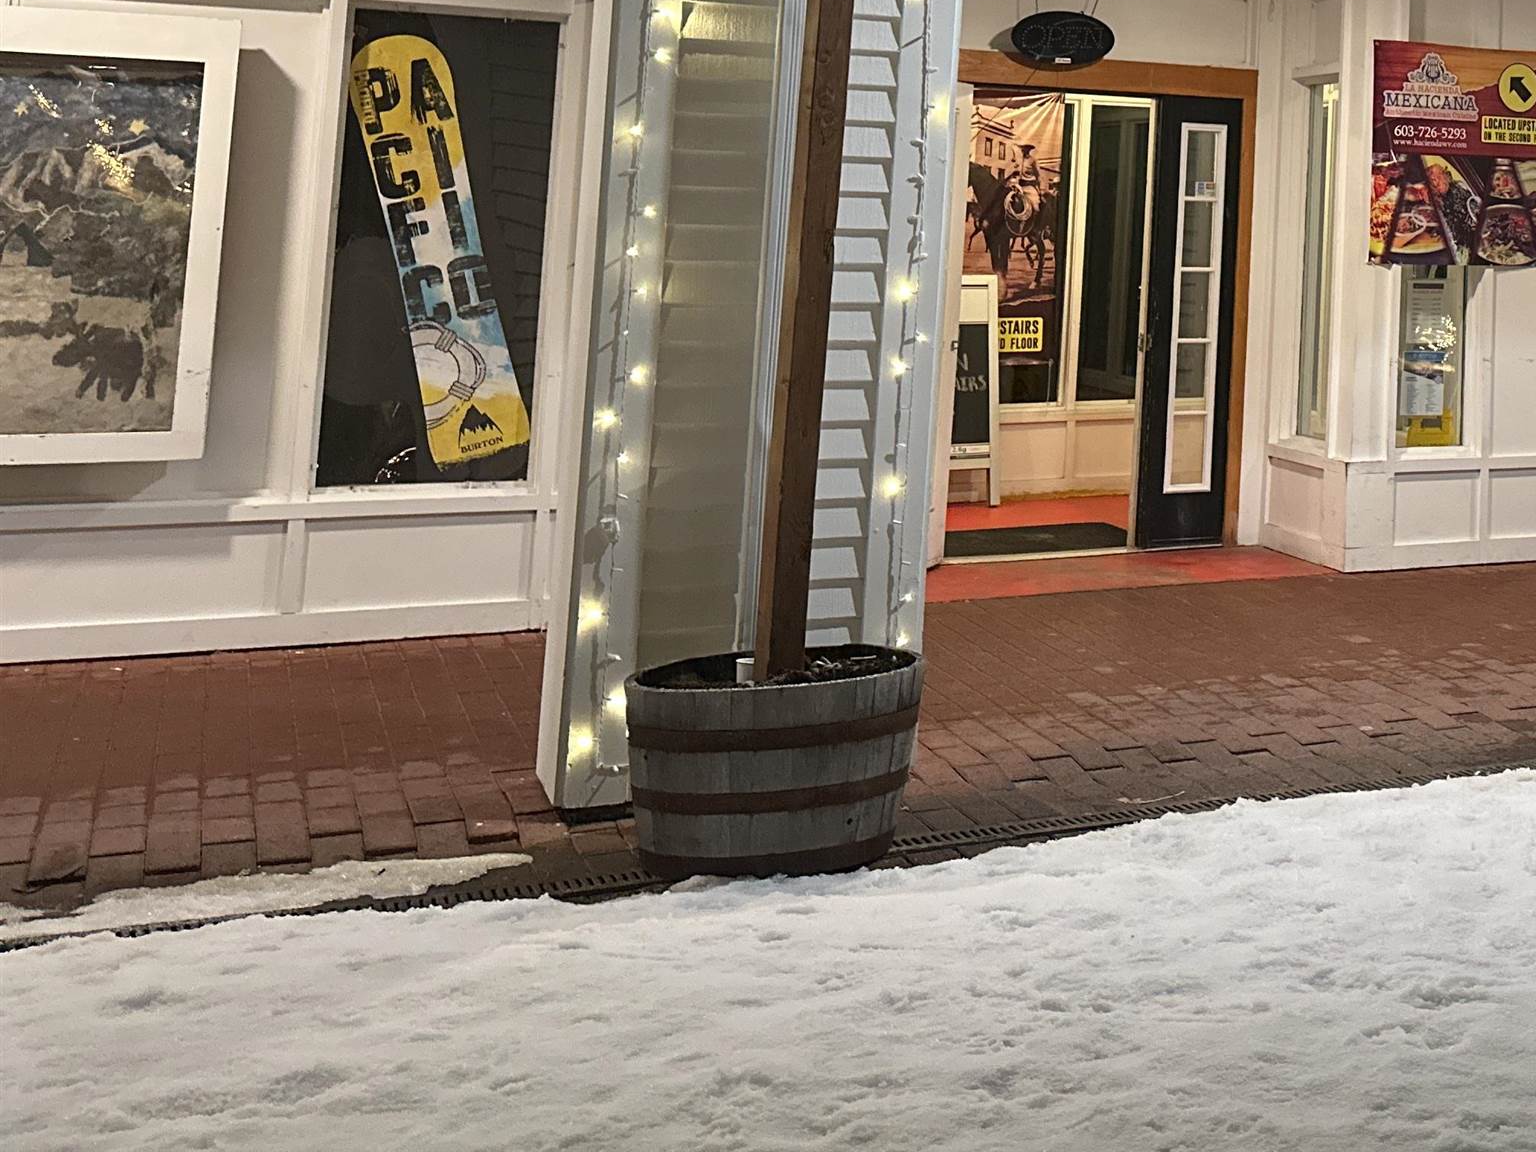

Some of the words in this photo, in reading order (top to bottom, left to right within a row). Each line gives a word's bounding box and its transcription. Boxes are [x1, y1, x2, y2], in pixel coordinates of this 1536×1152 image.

[1405, 84, 1414, 92] LA
[1418, 85, 1460, 94] HACIENDA
[1385, 92, 1477, 111] MEXICANA
[1484, 117, 1516, 130] LOCATED
[1394, 125, 1467, 139] 603-726-5293
[1484, 131, 1491, 140] ON
[1495, 132, 1506, 141] THE
[1508, 133, 1531, 143] SECOND
[1010, 337, 1038, 349] FLOOR
[461, 436, 504, 453] BURTON
